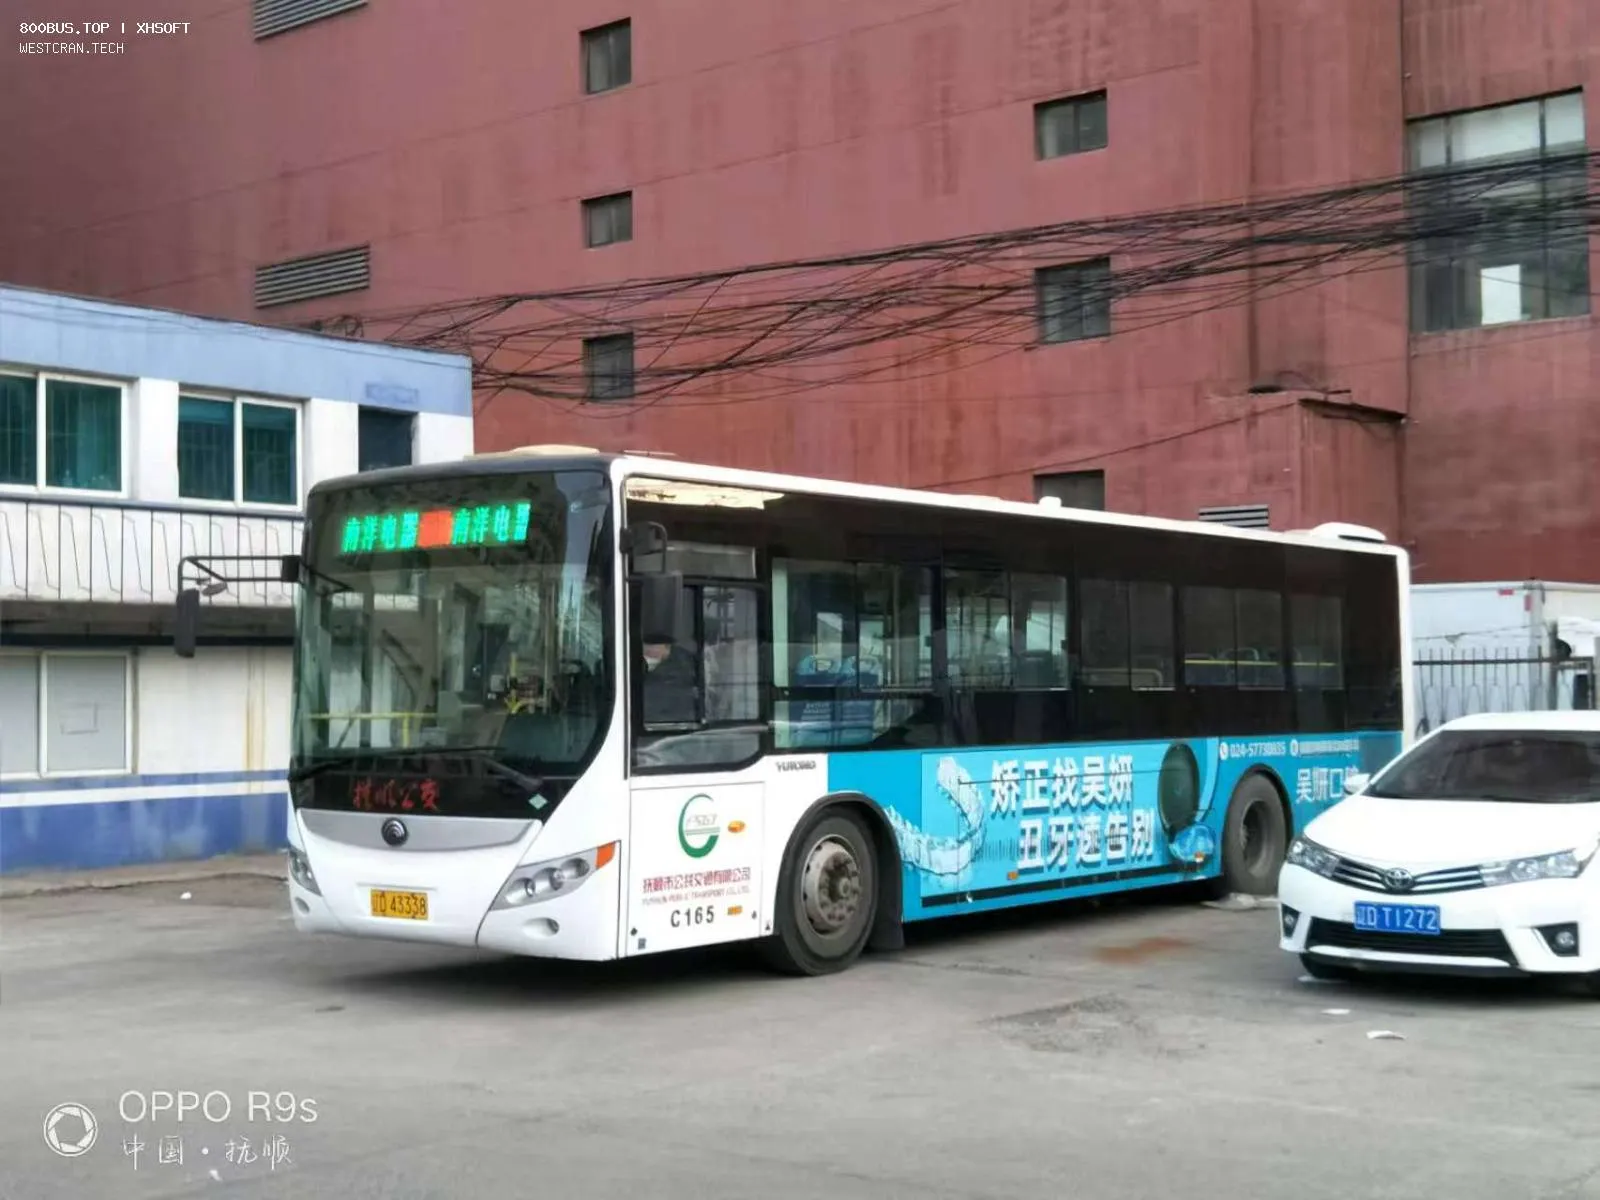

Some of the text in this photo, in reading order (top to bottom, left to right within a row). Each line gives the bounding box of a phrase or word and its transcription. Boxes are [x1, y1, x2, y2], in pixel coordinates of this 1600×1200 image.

[990, 754, 1134, 814] 矫正找吴妍
[1017, 807, 1156, 870] 丑牙速告别
[670, 905, 715, 928] C165
